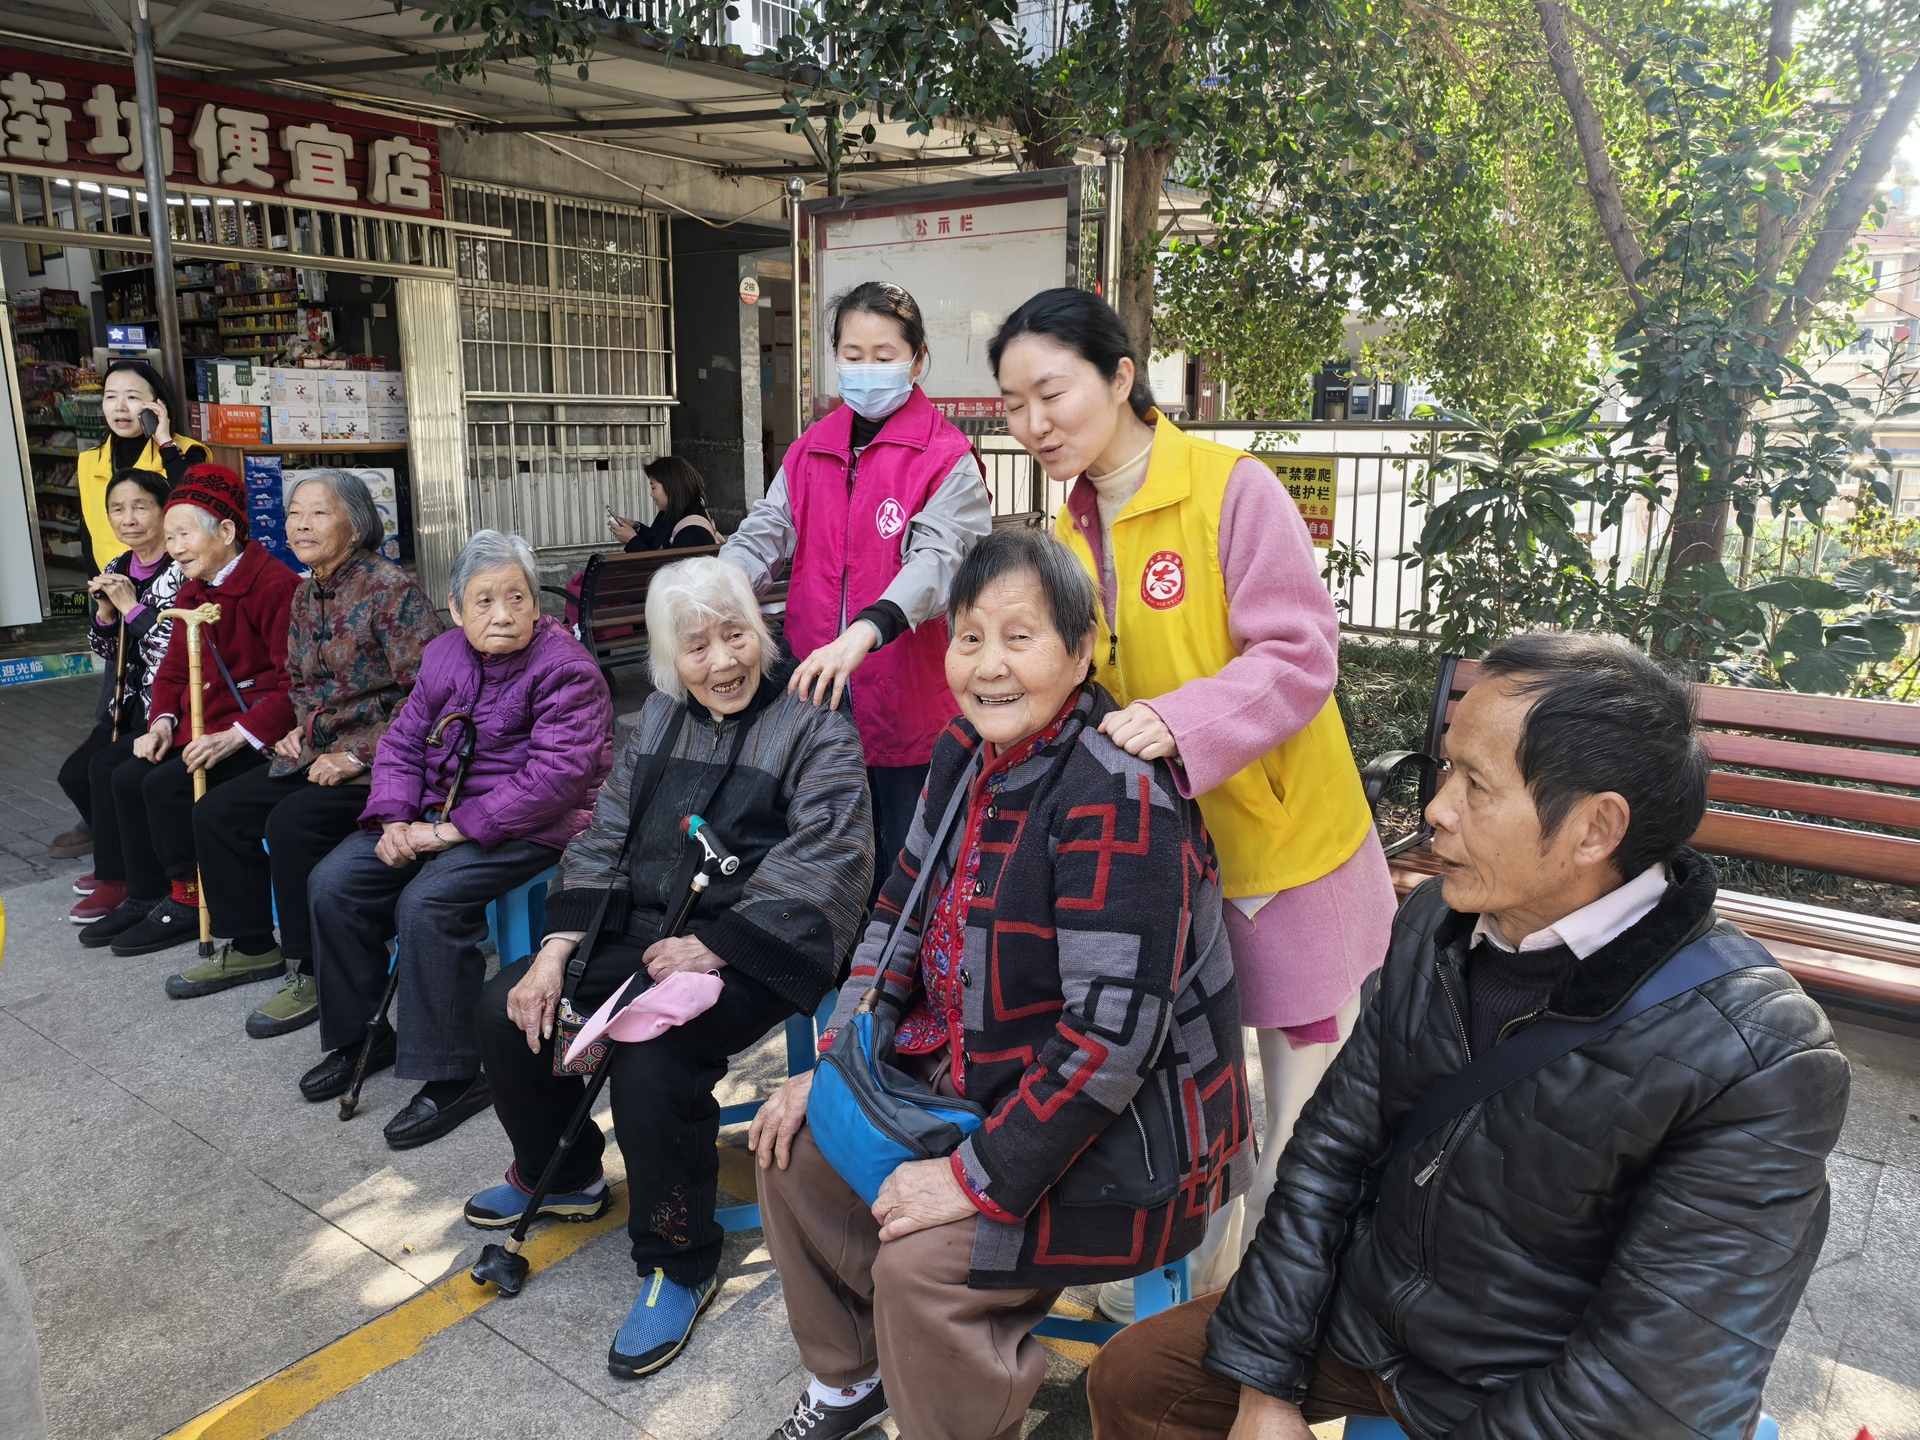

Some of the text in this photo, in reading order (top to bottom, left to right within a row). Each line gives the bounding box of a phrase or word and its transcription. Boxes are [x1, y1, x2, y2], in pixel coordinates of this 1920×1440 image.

[0, 72, 431, 210] 街坊便宜店
[916, 213, 973, 238] 公示栏
[744, 282, 756, 292] 2栋
[1276, 466, 1331, 482] 严禁攀爬
[1283, 484, 1330, 501] 越护栏
